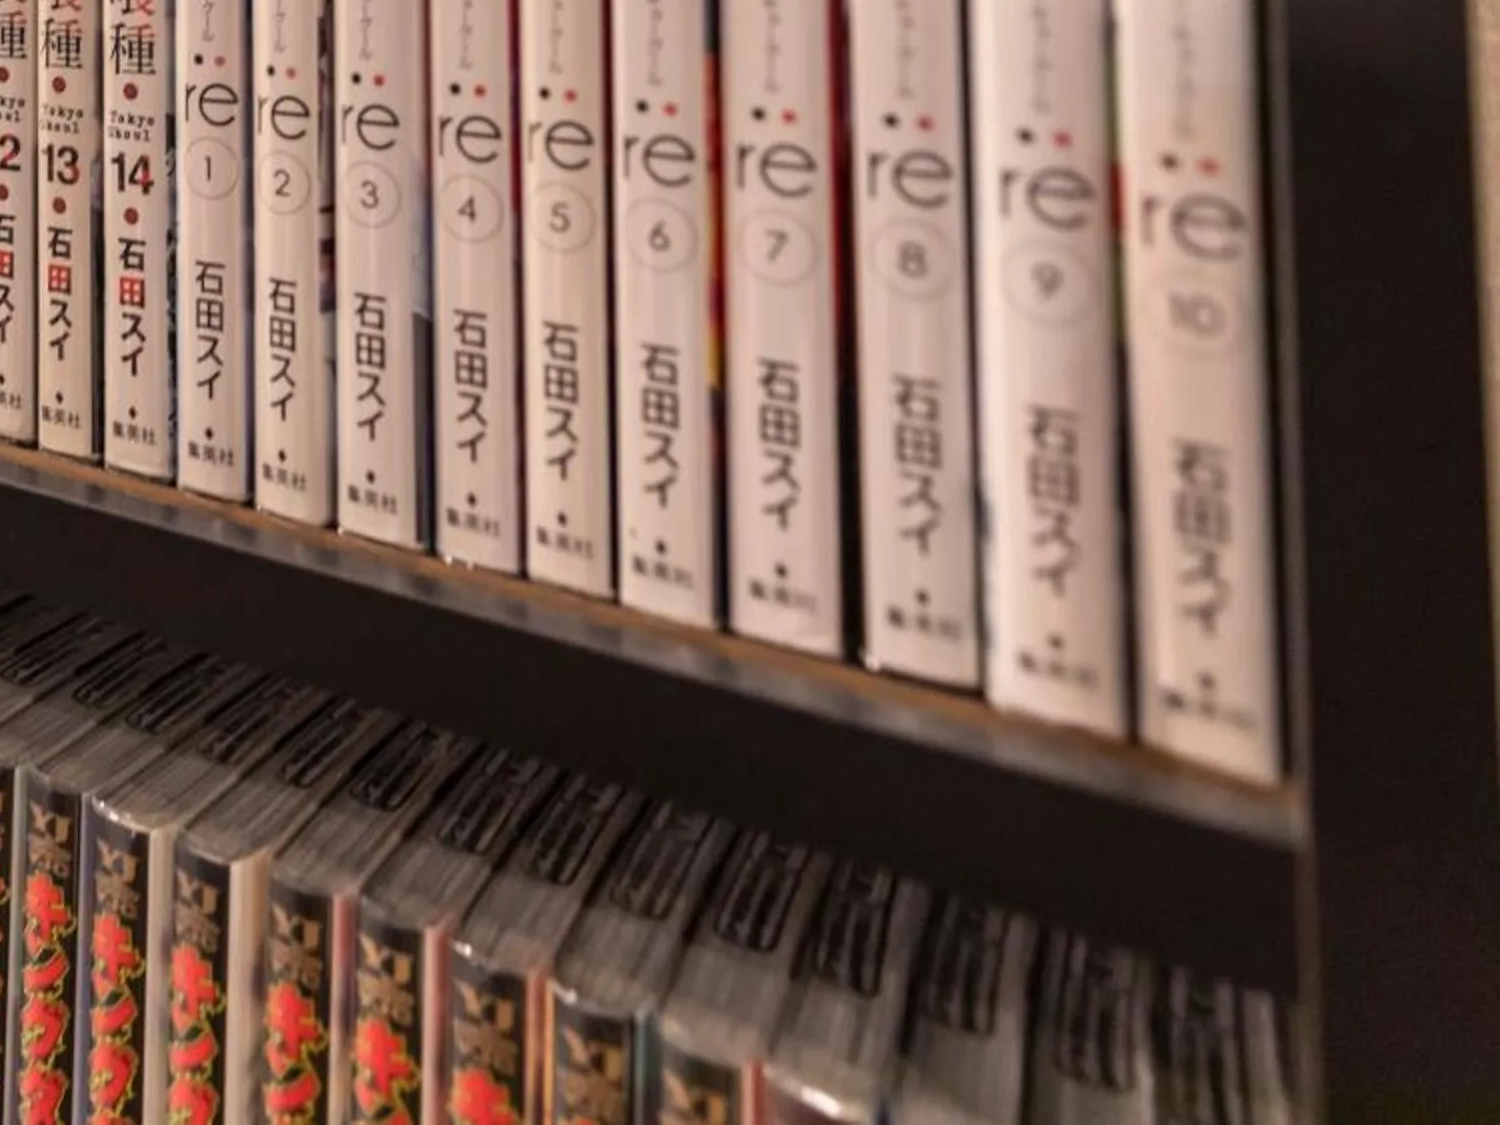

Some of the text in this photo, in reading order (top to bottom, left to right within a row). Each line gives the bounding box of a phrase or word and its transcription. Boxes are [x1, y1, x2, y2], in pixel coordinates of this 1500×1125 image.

[41, 144, 80, 185] 13
[111, 151, 154, 195] 14
[47, 227, 72, 361] 石田スイ
[118, 237, 146, 376] 石田スイ
[196, 260, 226, 400] 石田スイ
[268, 278, 296, 421] 石田スイ
[355, 292, 386, 441] 石田スイ
[453, 308, 488, 463] 石田スイ
[543, 321, 579, 482] 石田スイ
[640, 342, 680, 510] 石田スイ
[758, 356, 799, 530] 石田スイ
